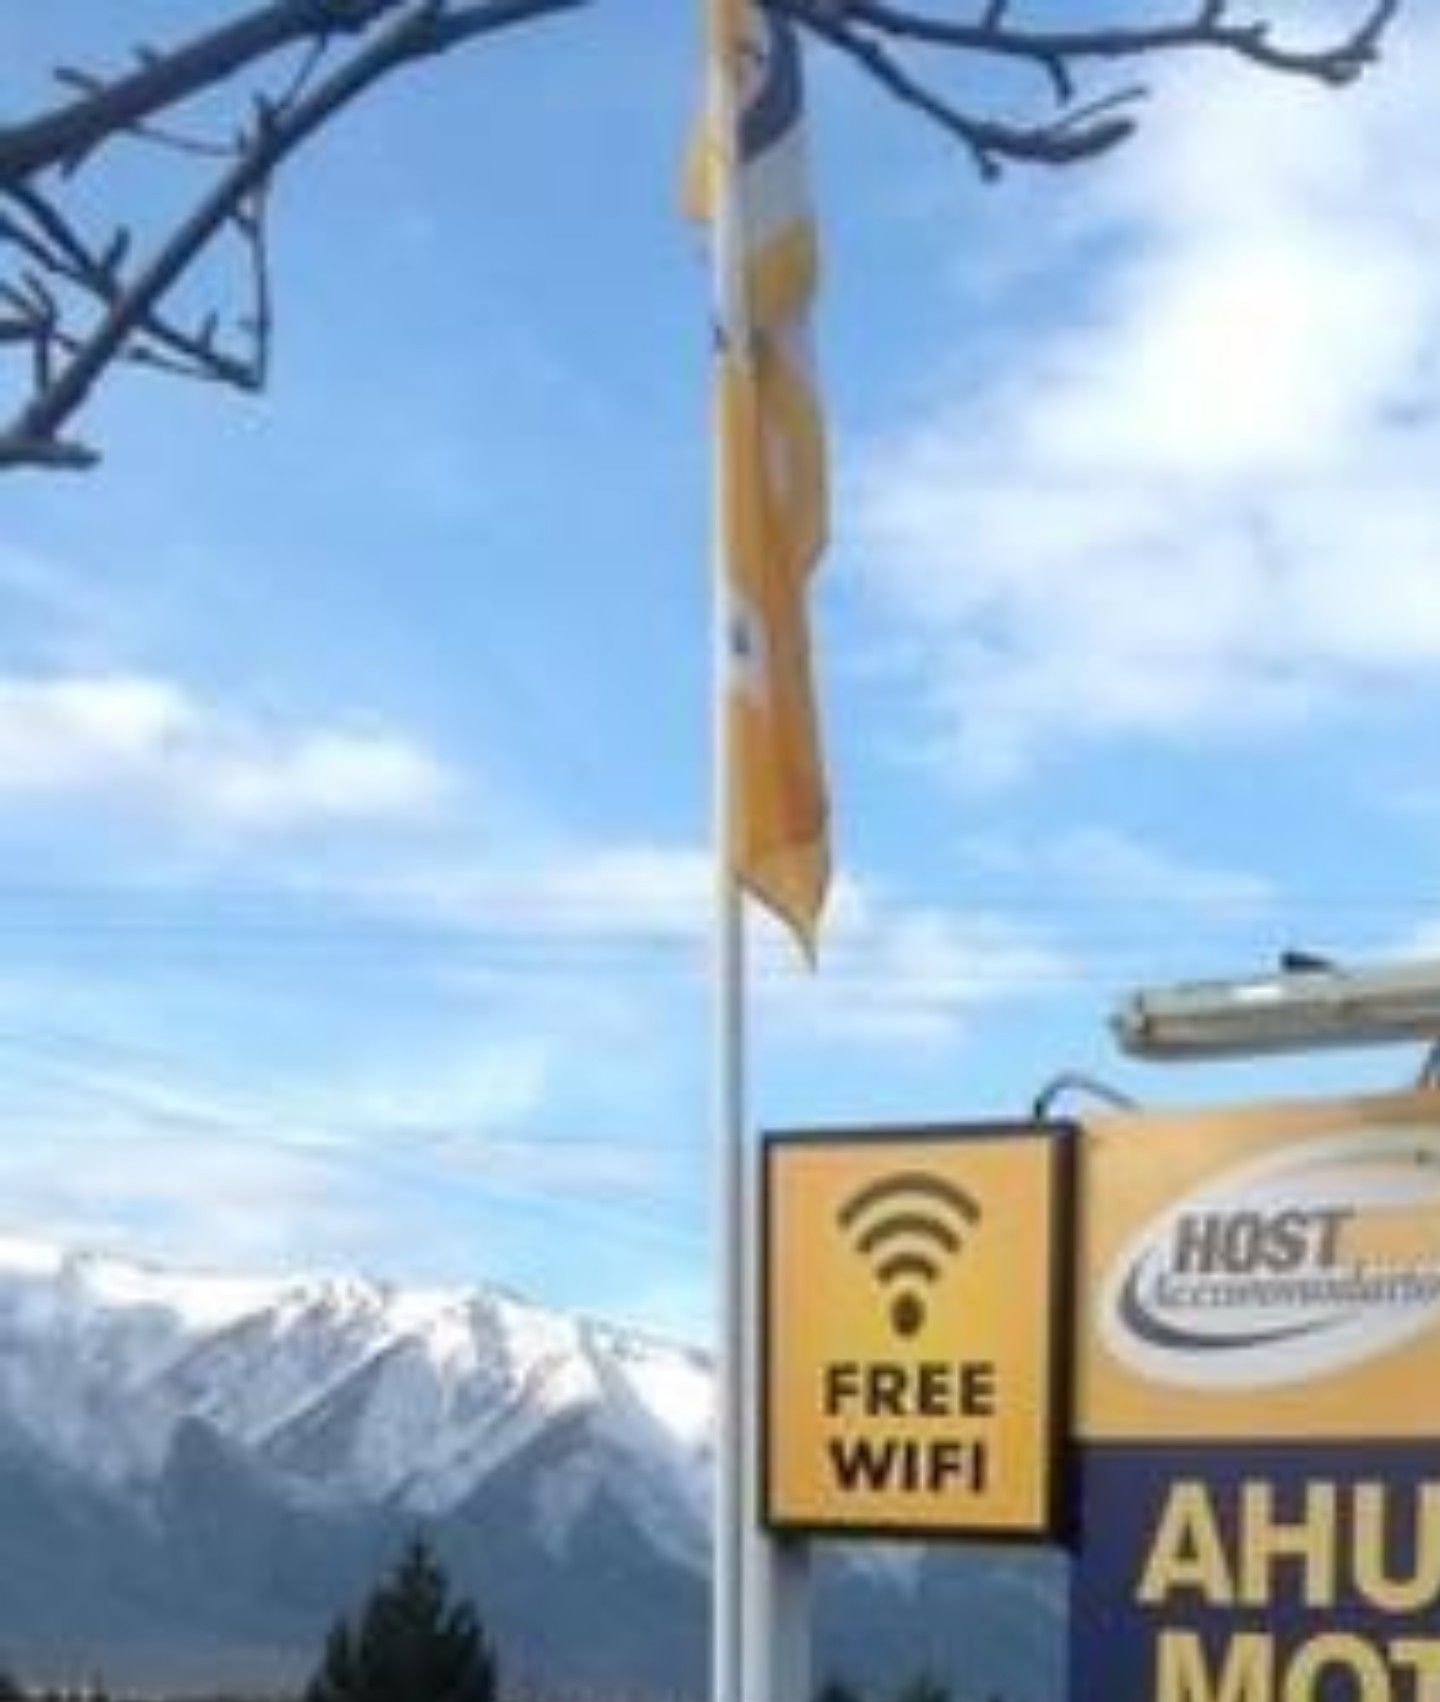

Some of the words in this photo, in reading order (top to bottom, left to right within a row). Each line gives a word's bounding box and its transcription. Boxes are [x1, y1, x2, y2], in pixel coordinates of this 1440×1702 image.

[1173, 1204, 1356, 1275] HOST
[824, 1362, 995, 1416] FREE
[830, 1439, 989, 1494] WIFI
